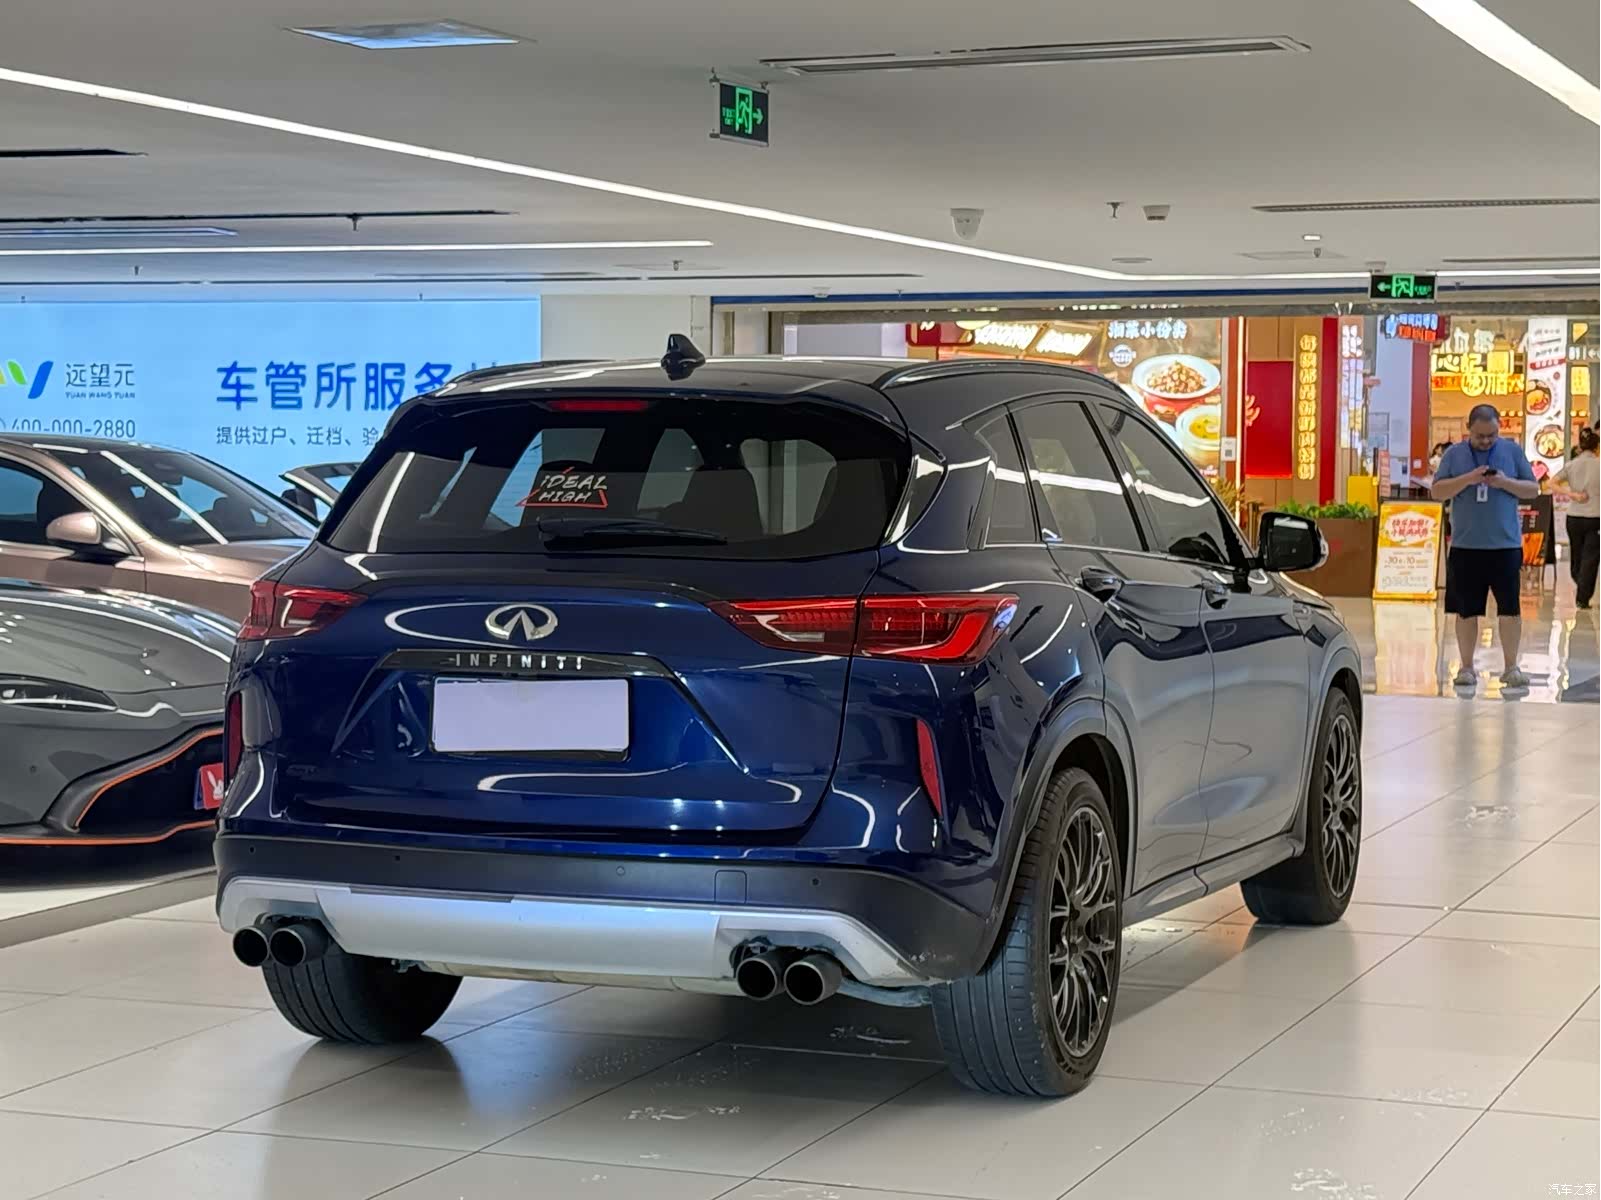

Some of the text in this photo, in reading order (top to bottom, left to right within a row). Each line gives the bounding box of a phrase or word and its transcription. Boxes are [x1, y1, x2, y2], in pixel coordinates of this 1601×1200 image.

[65, 362, 136, 387] 远望元
[65, 391, 87, 399] YUAN
[114, 391, 136, 399] YUAN
[215, 360, 498, 411] 车管所服务
[538, 490, 592, 503] HIGH
[455, 652, 583, 671] INFINITI
